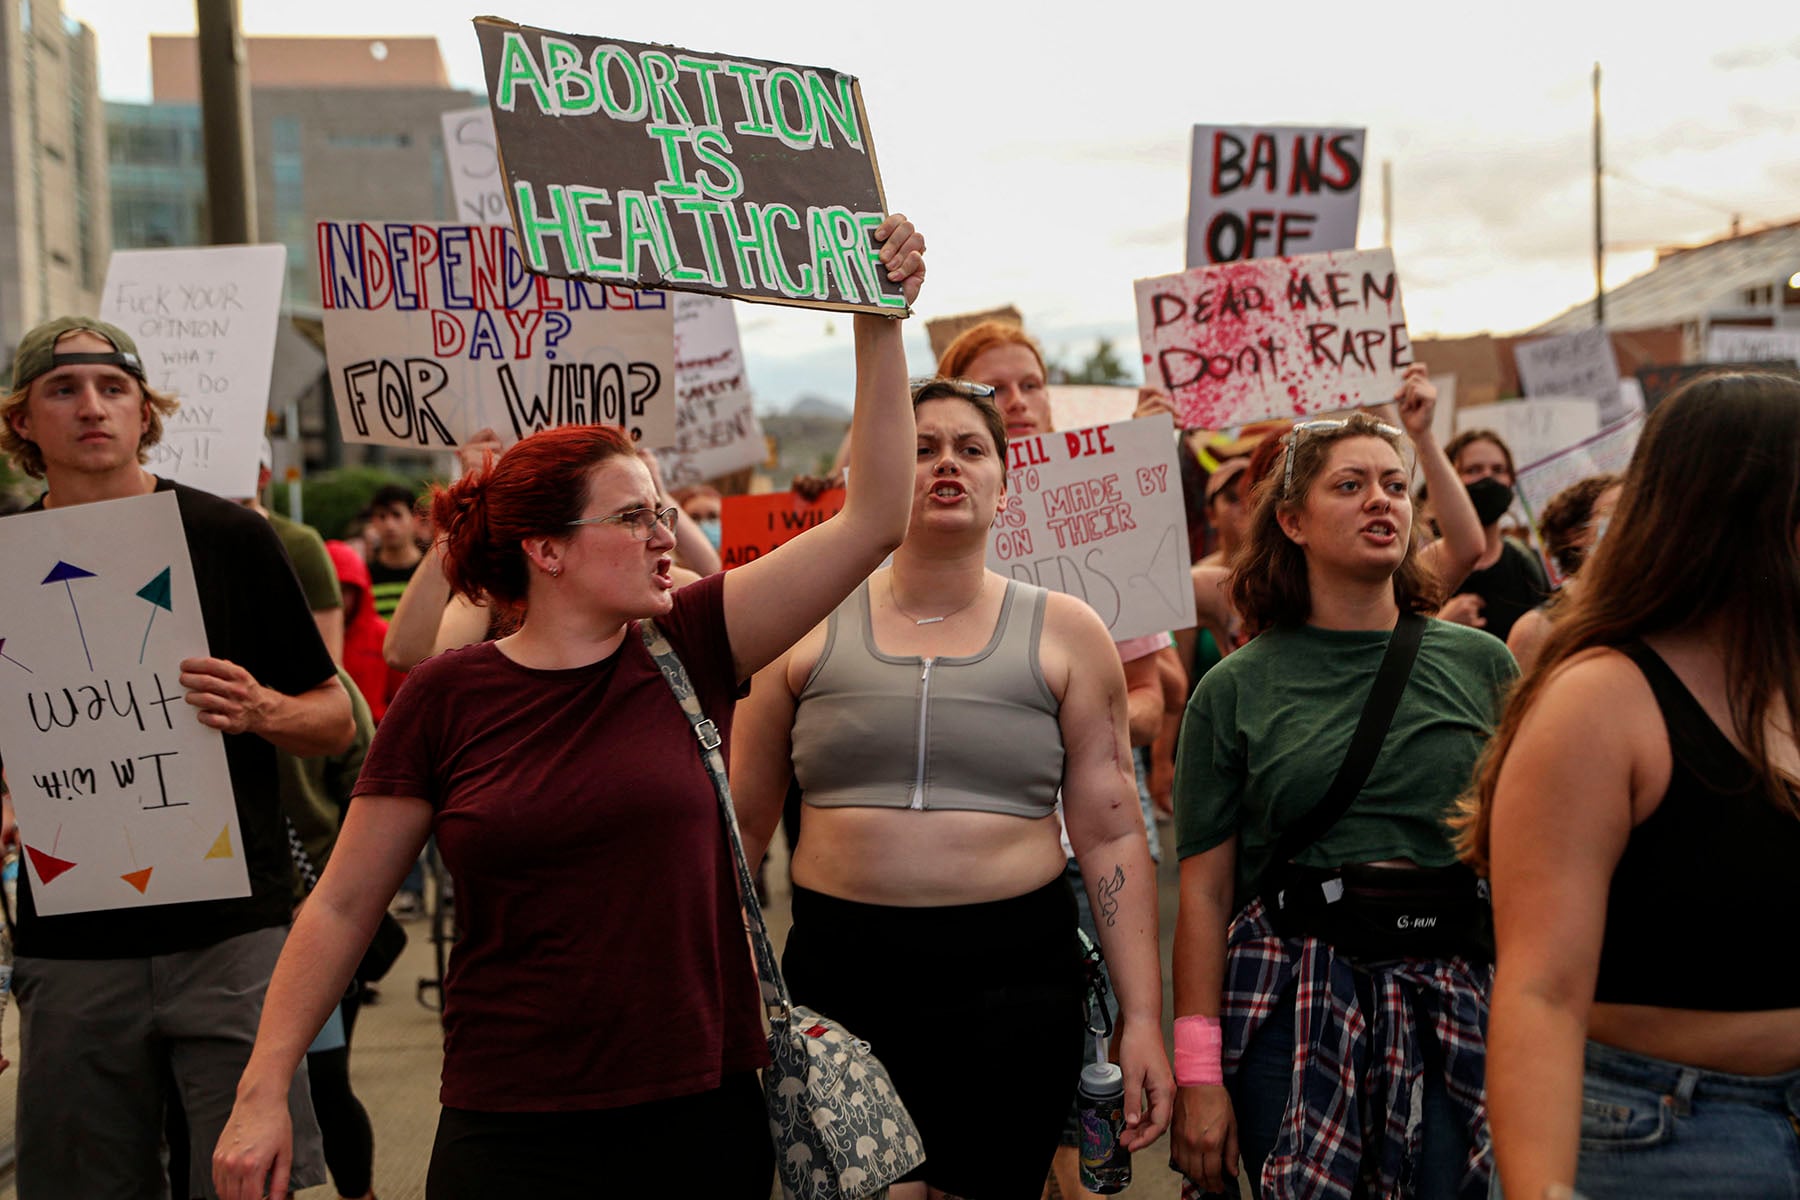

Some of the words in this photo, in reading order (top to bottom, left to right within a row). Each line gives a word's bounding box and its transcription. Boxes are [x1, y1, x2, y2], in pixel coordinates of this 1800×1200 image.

[497, 32, 865, 154] ABORTION
[647, 124, 743, 199] IS
[1211, 130, 1361, 196] BANS
[514, 181, 907, 308] HEALTHCARE
[1205, 209, 1317, 263] OFF
[179, 281, 243, 312] YOUR
[1152, 282, 1265, 328] DEAD
[1287, 272, 1397, 312] MEN
[139, 316, 231, 338] OPINION
[431, 309, 571, 360] DAY?
[1306, 323, 1412, 374] RAPE
[161, 349, 216, 365] WHAT
[199, 374, 229, 394] DO
[344, 359, 457, 446] FOR
[497, 362, 661, 442] WHO?
[180, 406, 214, 424] MY
[1005, 436, 1051, 471] ILL
[1065, 424, 1115, 459] DIE
[1008, 467, 1040, 494] TO
[1041, 474, 1123, 518] MADE
[1136, 463, 1168, 496] BY
[995, 528, 1033, 561] ON
[1047, 502, 1137, 549] THEIR
[28, 673, 182, 732] them
[32, 766, 96, 801] with
